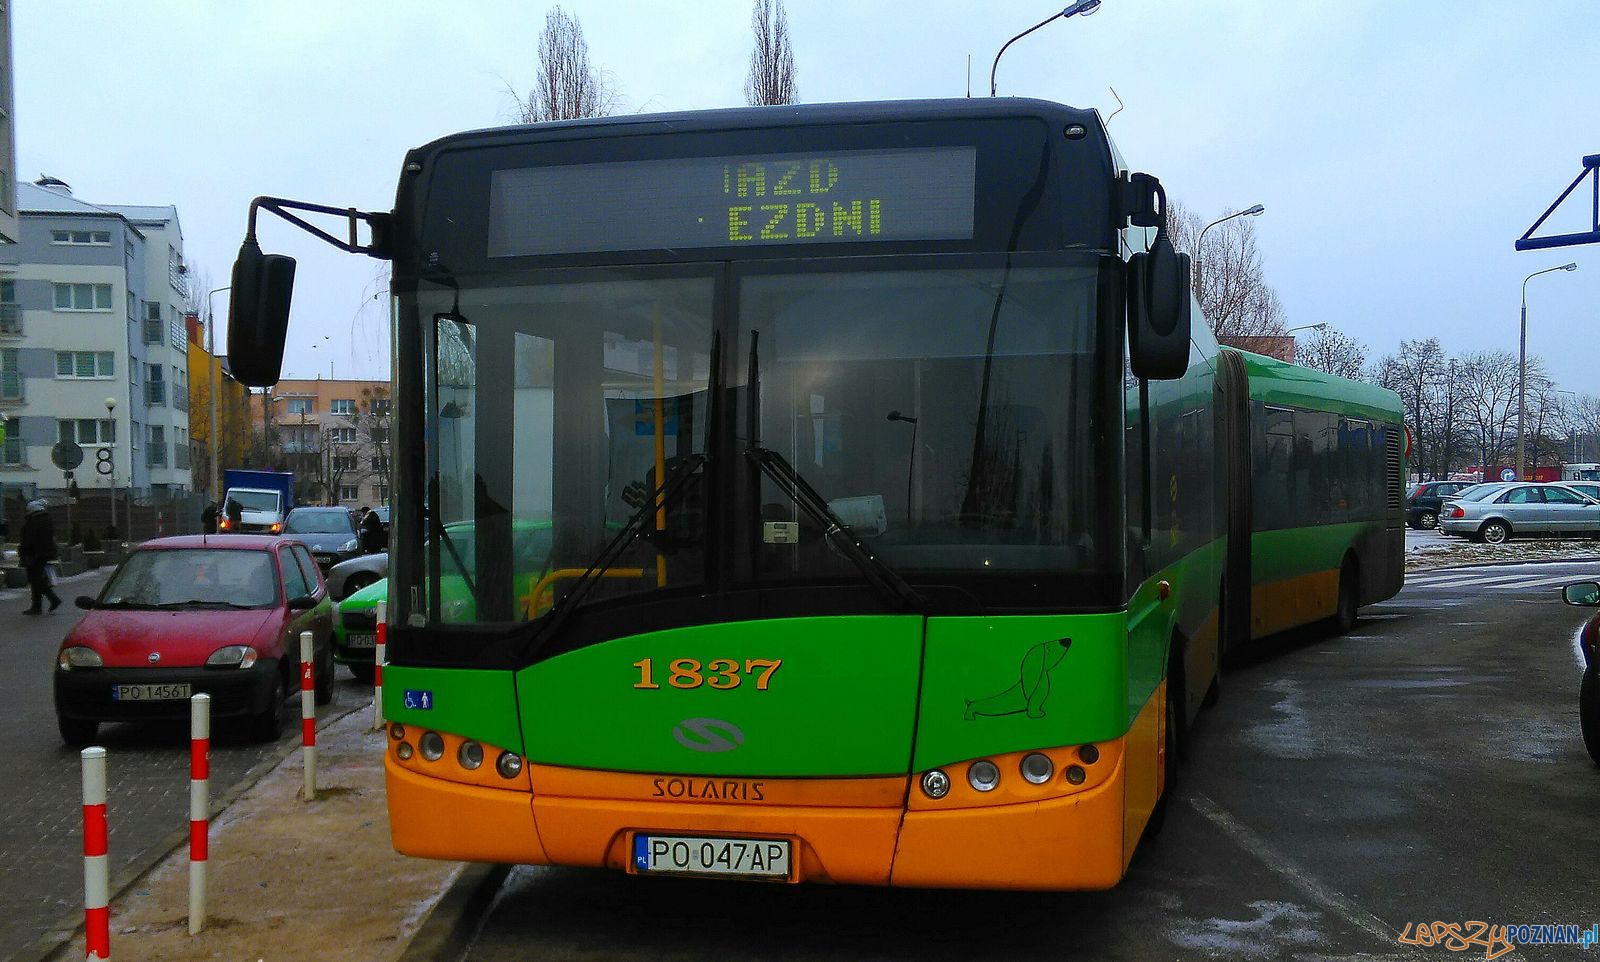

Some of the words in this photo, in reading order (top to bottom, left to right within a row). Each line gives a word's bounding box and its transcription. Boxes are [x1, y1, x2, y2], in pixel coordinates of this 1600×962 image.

[96, 448, 114, 475] 8
[633, 658, 783, 691] 1837
[120, 686, 140, 699] PO
[146, 685, 189, 699] 1456T
[652, 778, 764, 801] SOLARIS
[637, 856, 647, 865] PL
[652, 840, 691, 869] PO
